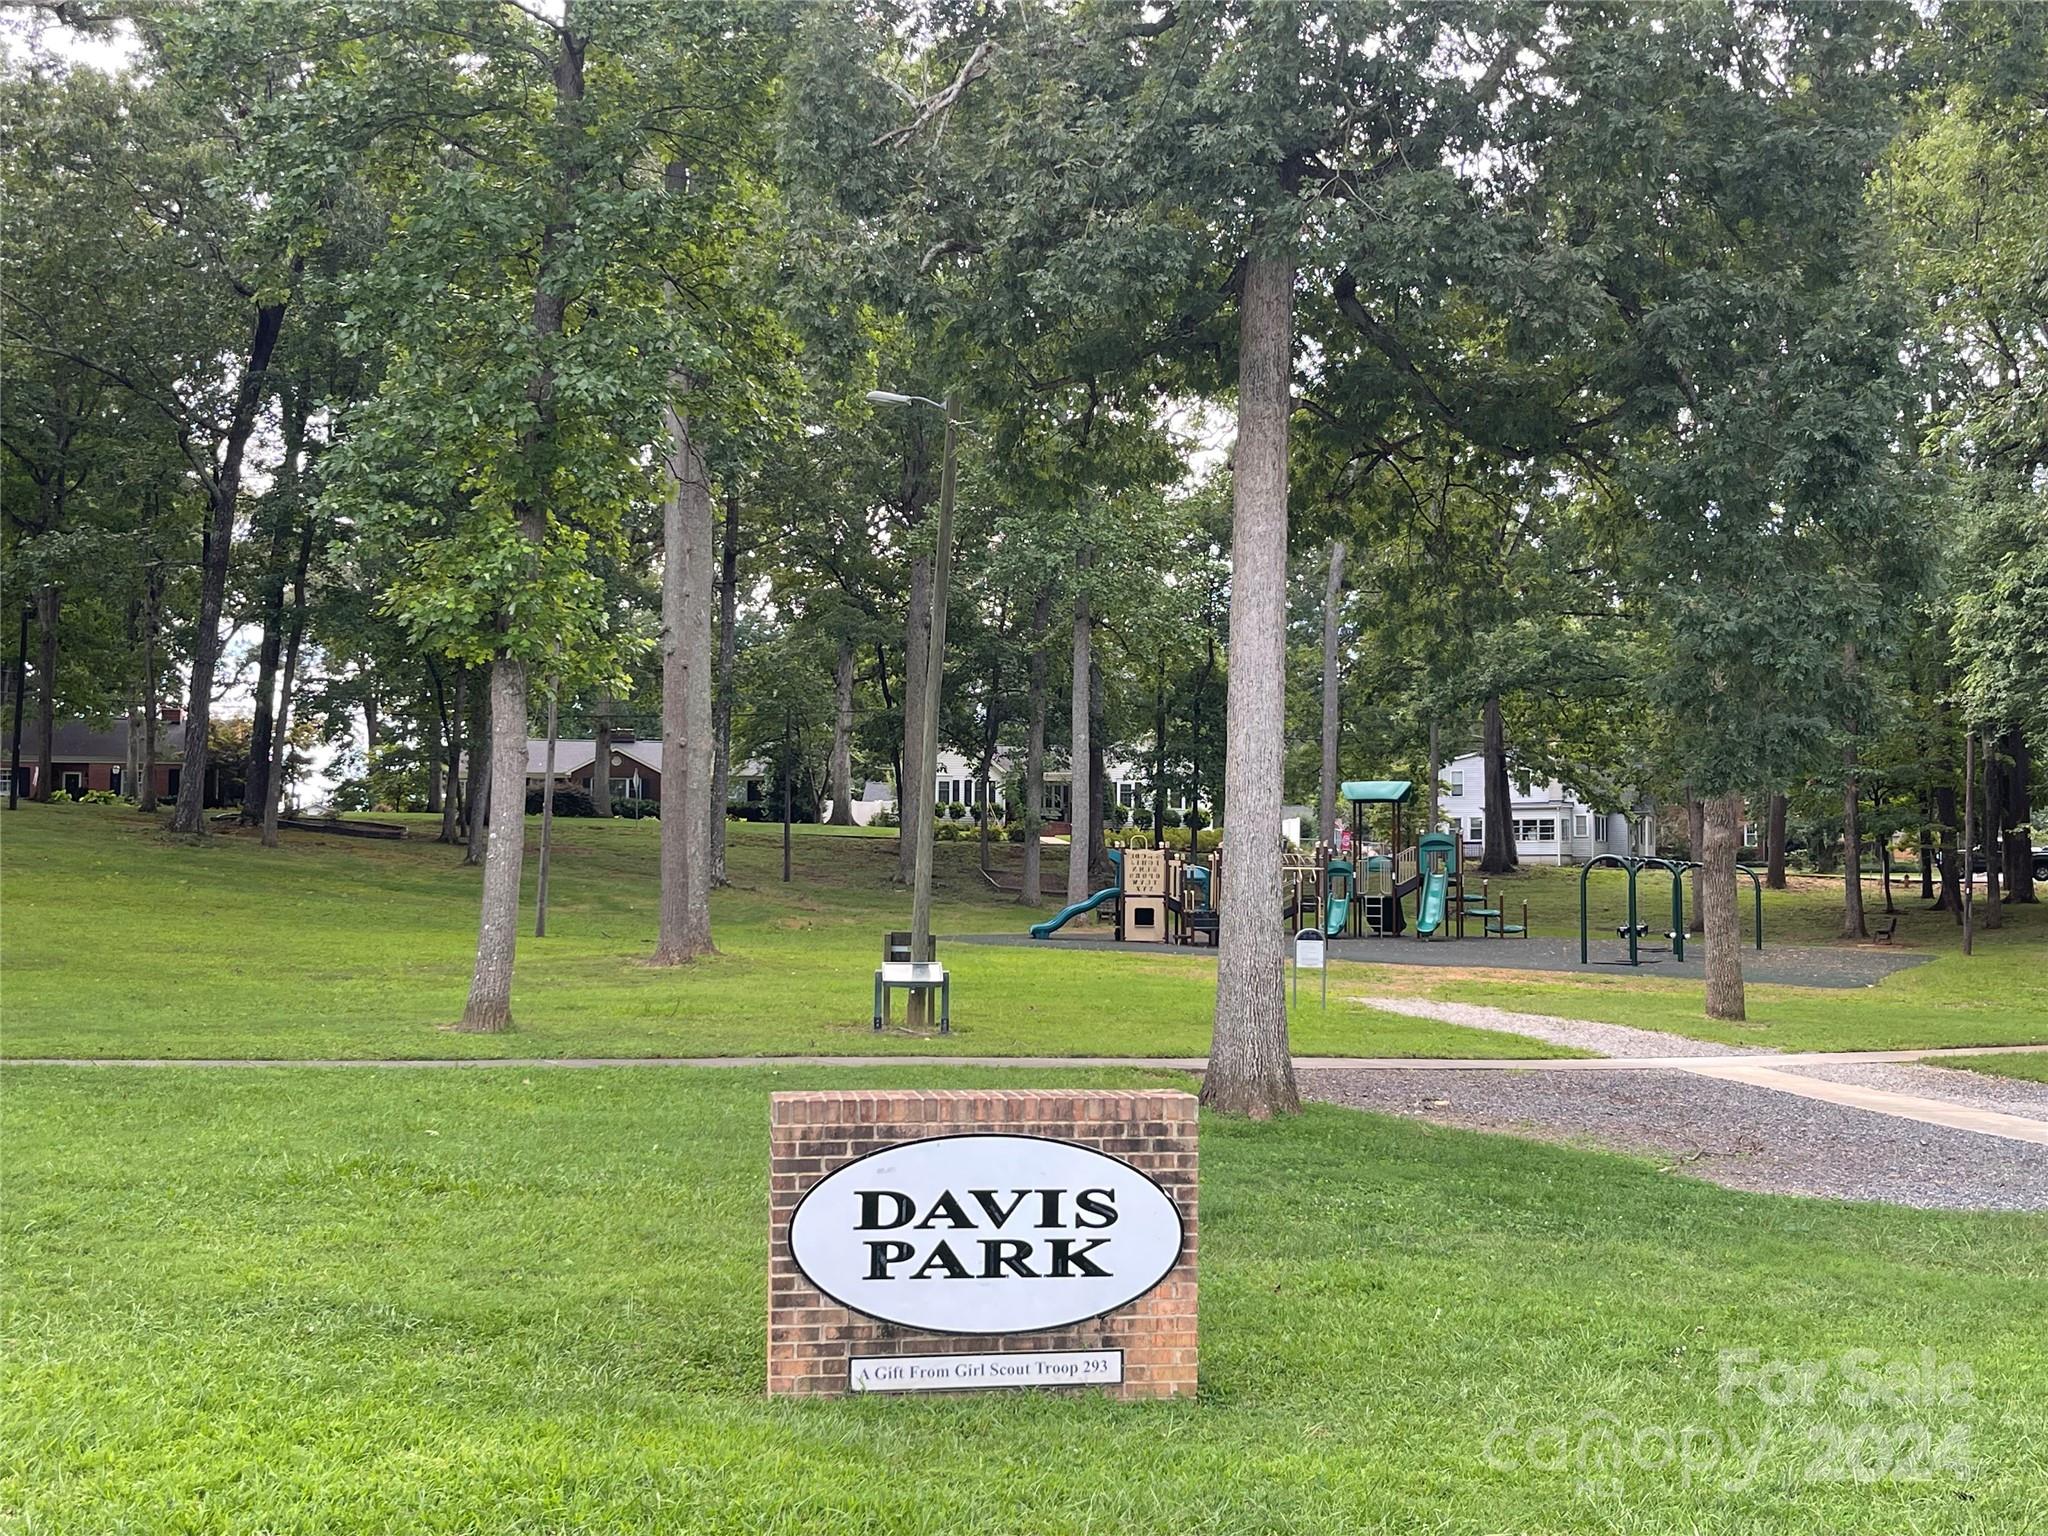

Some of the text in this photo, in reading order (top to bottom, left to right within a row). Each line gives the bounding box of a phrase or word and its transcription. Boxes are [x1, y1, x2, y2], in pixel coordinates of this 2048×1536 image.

[853, 1188, 1119, 1230] DAVIS
[862, 1239, 1114, 1280] PARK
[860, 1359, 1108, 1380] A Gift From Girl Scout Troop 293
